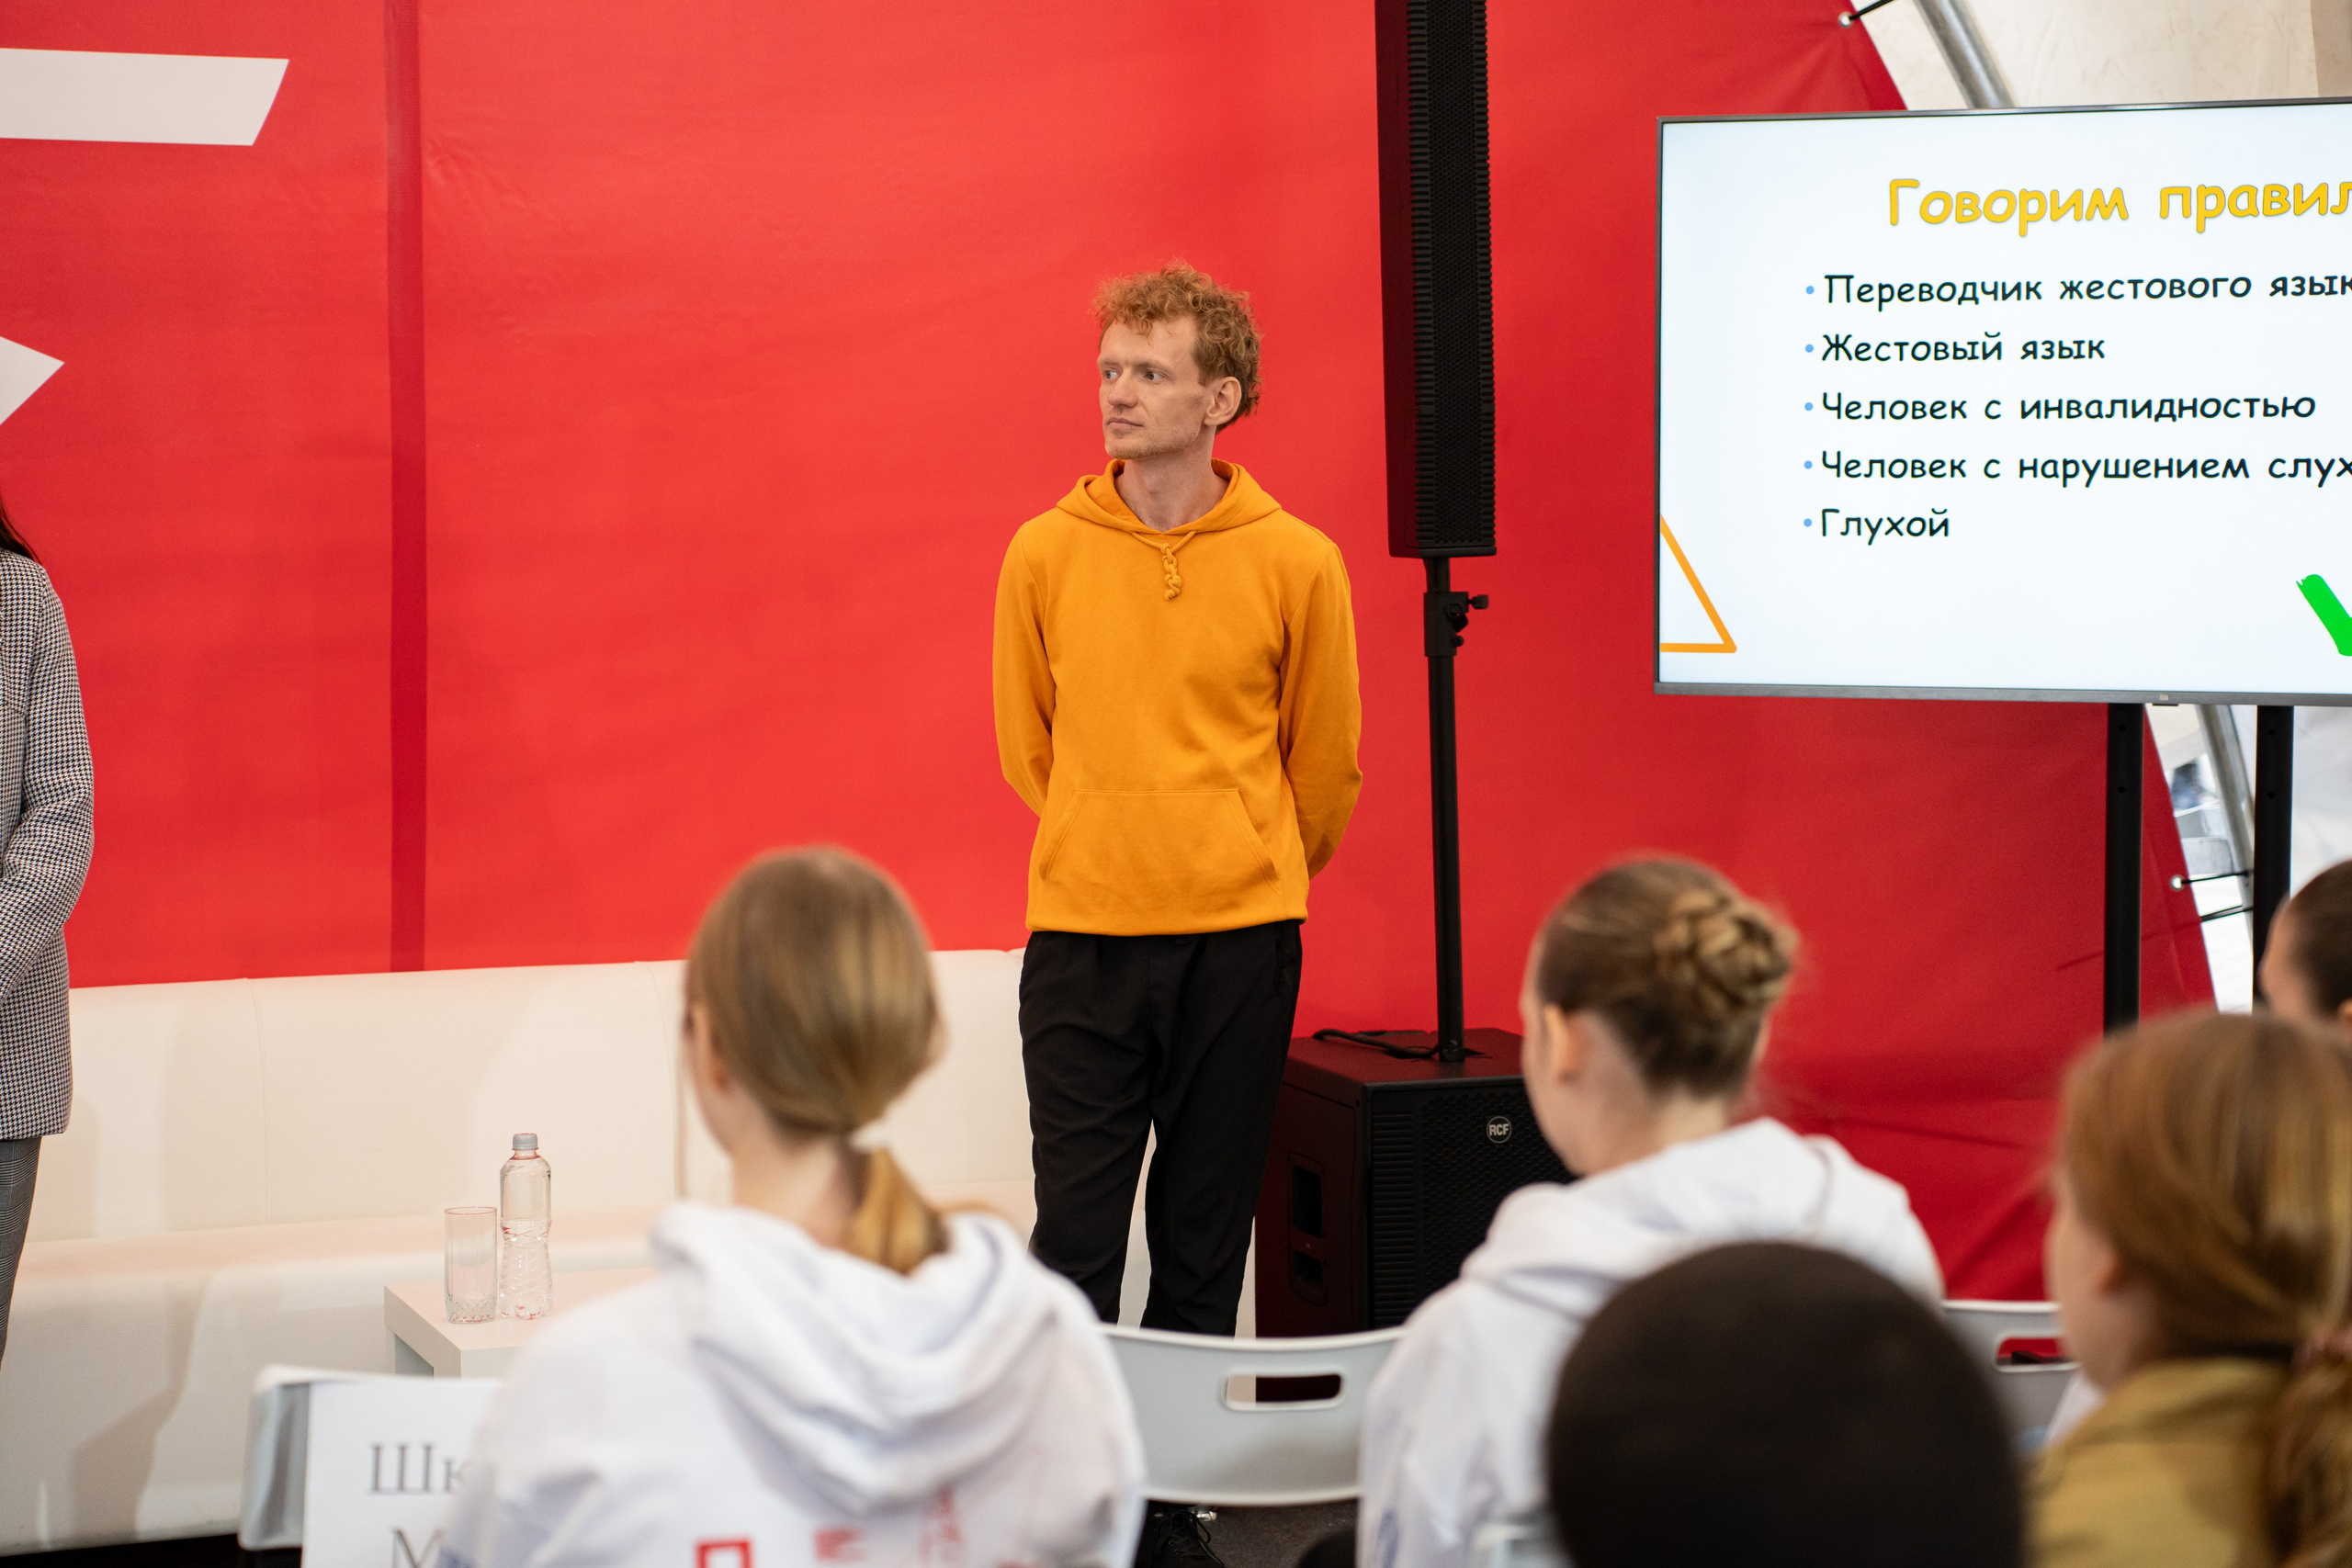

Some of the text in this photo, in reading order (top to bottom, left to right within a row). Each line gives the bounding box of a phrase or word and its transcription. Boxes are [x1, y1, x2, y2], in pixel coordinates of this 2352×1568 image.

[1889, 178, 2352, 238] Говорим правил
[1824, 274, 2043, 313] Переводчик
[2059, 276, 2253, 300] жестового
[1821, 331, 2106, 362] Жестовый язык
[1822, 391, 2316, 423] Человек с инвалидностью
[1821, 450, 2352, 489] Человек с нарушением слух
[1821, 507, 1950, 547] Глухой
[1488, 1123, 1510, 1136] RCF
